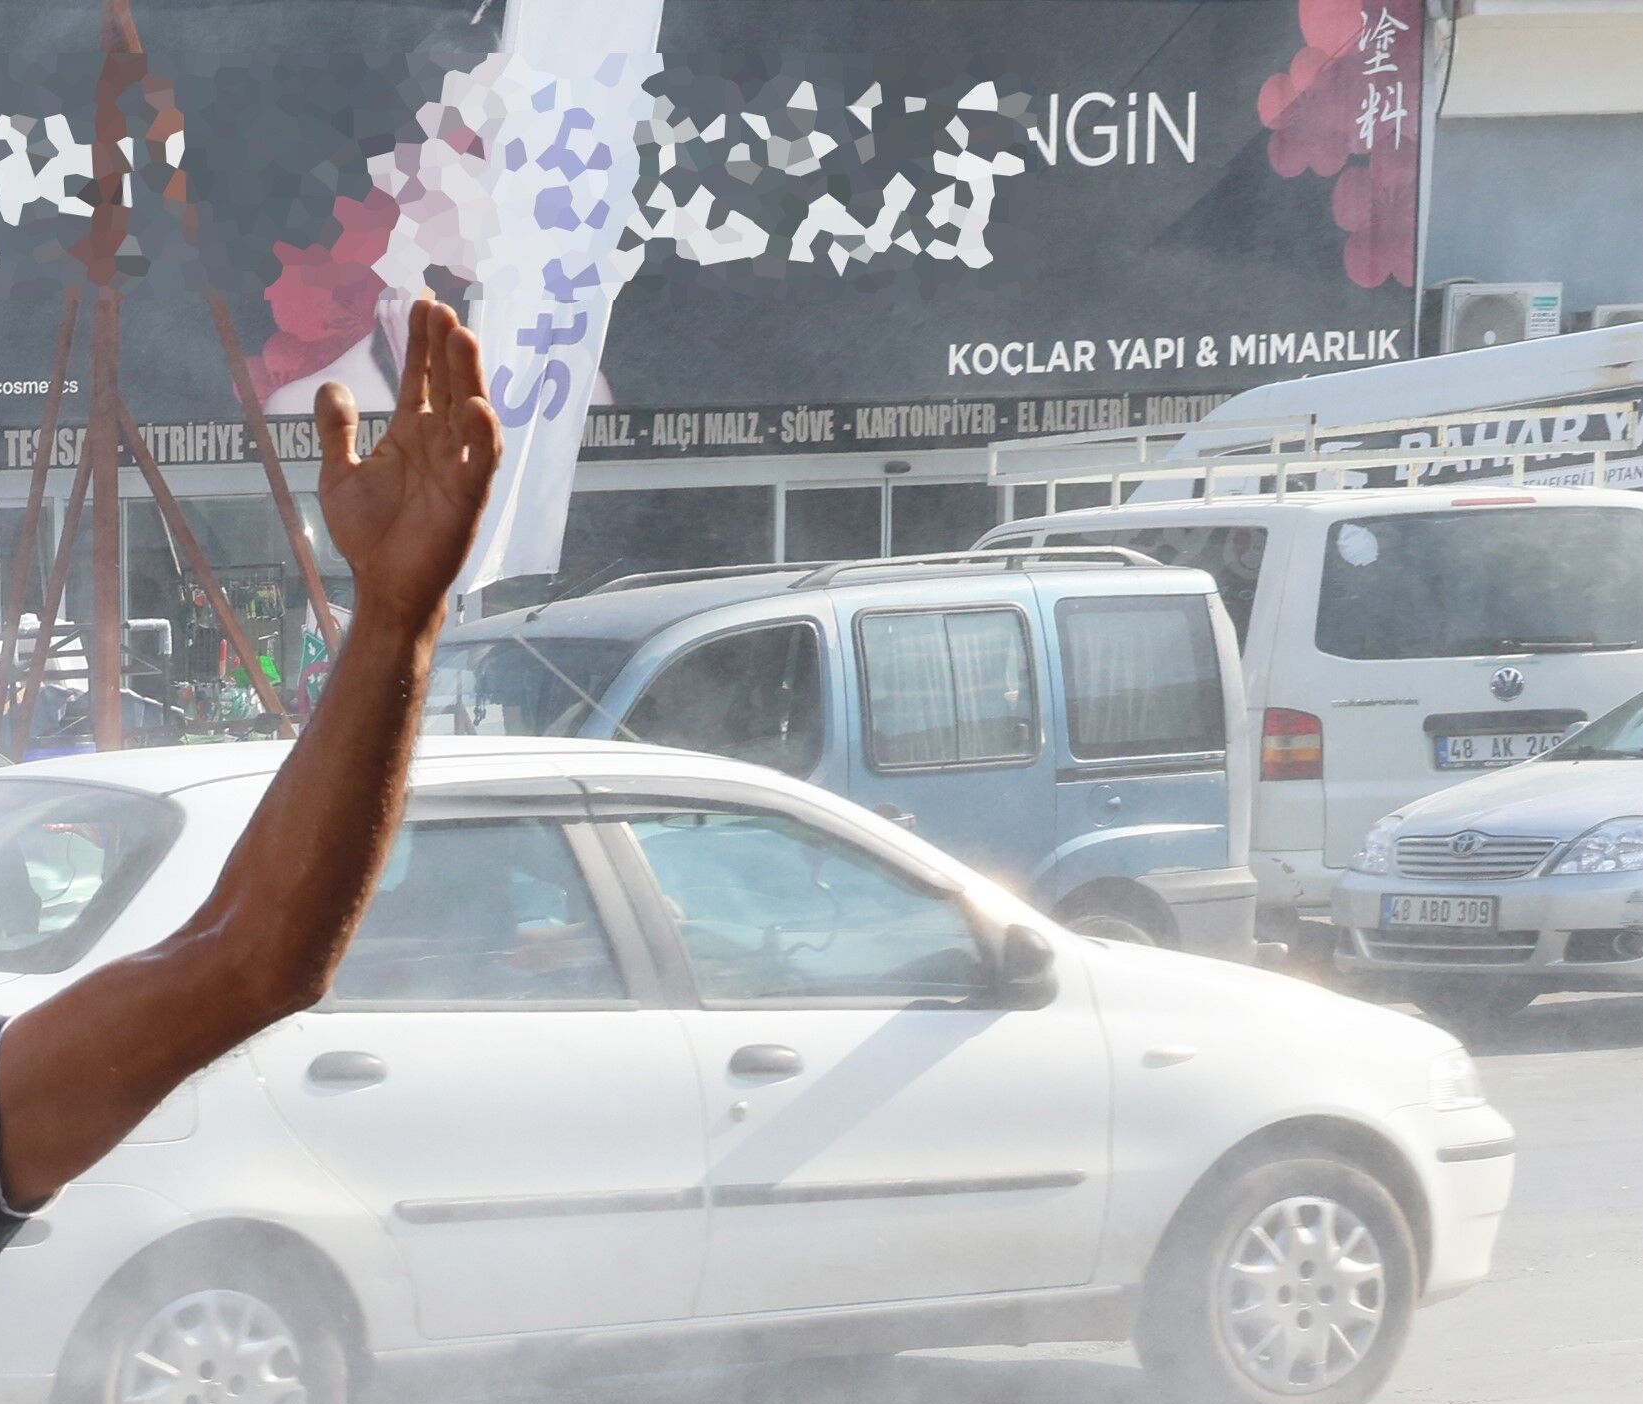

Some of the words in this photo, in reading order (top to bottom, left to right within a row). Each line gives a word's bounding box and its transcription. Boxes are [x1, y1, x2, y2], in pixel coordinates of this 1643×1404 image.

[947, 340, 1096, 376] KOÇLAR
[1107, 336, 1185, 371] YAPI
[1195, 335, 1219, 368] &
[651, 411, 700, 452] ALÇI
[704, 411, 764, 445] MALZ.
[780, 405, 835, 444] SÖVE
[855, 400, 996, 440] KARTONPİYER
[1017, 401, 1042, 433] EL
[1450, 738, 1473, 759] 48
[1491, 736, 1514, 758] AK
